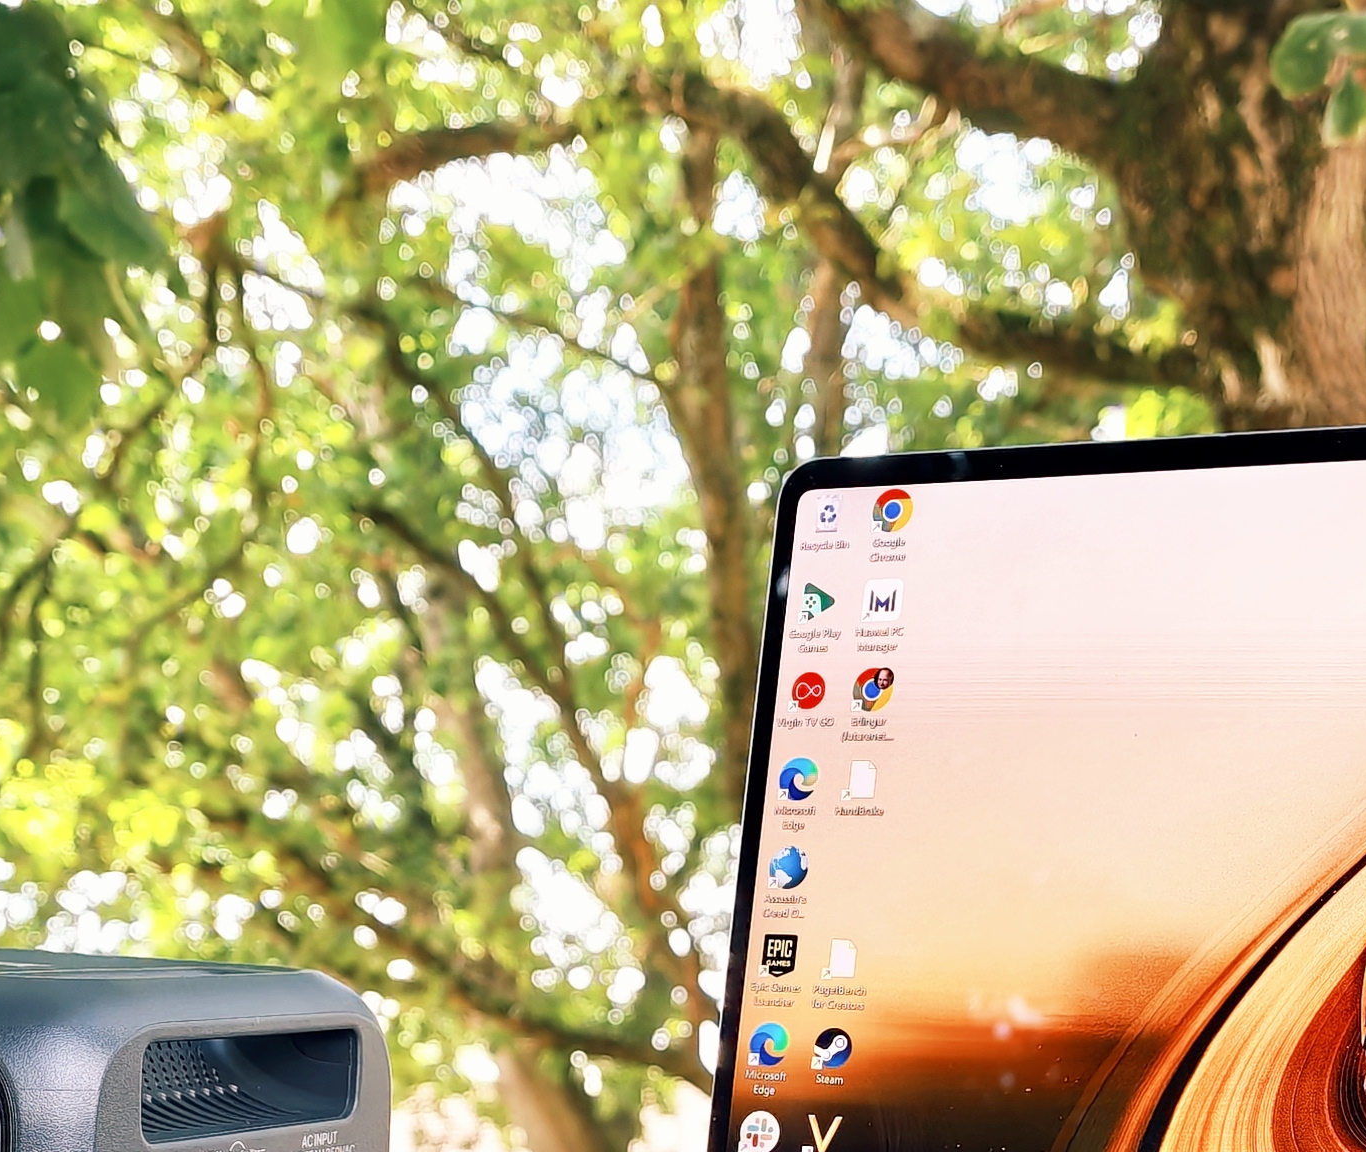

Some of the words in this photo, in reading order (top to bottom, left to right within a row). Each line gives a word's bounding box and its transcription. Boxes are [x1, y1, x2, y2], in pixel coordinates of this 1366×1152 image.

[872, 538, 905, 549] Google
[789, 629, 821, 641] Google
[823, 628, 841, 640] Play
[890, 627, 904, 636] PC
[805, 718, 818, 727] TV
[774, 806, 816, 815] Microsoft
[834, 806, 885, 816] HandBrake
[782, 820, 805, 832] Edge
[766, 939, 793, 958] EPIC
[750, 983, 769, 994] Epic
[812, 984, 867, 997] PugetBench
[811, 999, 825, 1009] for
[827, 1000, 865, 1011] Creators
[745, 1069, 787, 1081] Microsoft
[816, 1074, 843, 1085] Steam
[753, 1085, 775, 1097] Edge
[301, 1134, 314, 1147] AC
[315, 1131, 338, 1146] INPUT
